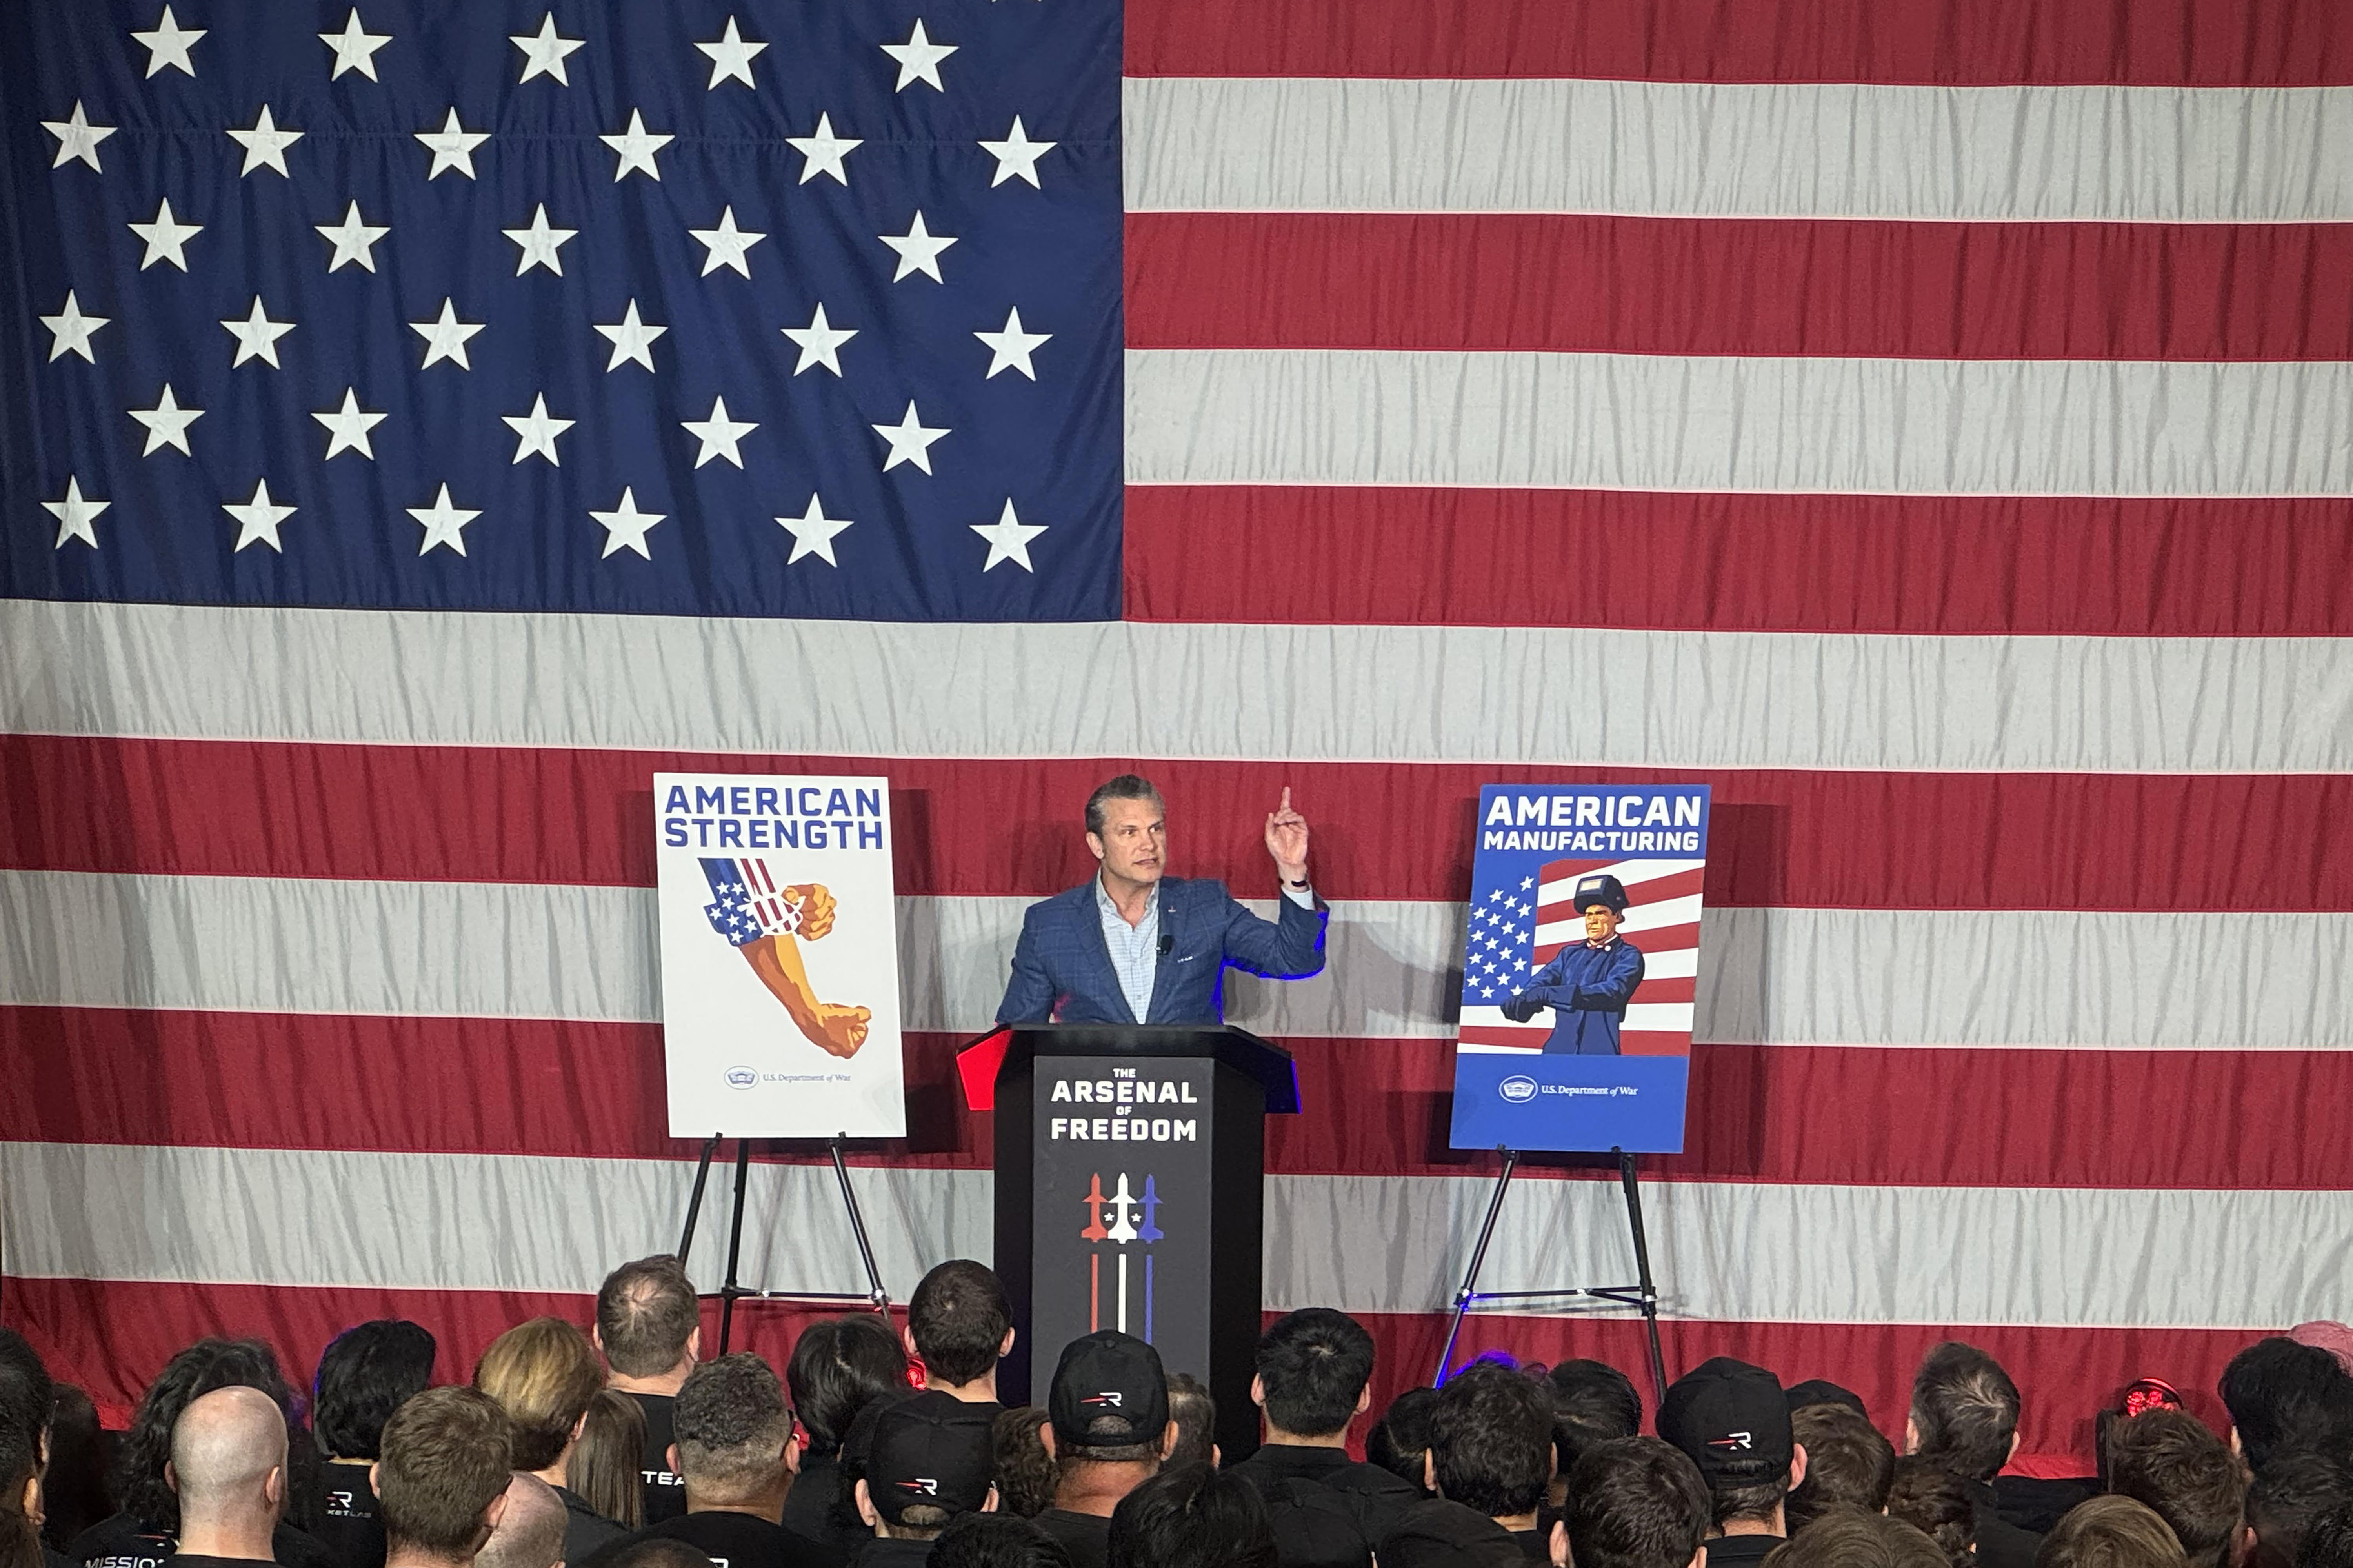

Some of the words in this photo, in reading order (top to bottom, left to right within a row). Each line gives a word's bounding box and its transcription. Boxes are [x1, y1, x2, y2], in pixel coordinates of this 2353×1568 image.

[665, 785, 880, 817] AMERICAN
[1485, 796, 1701, 827] AMERICAN
[665, 818, 883, 849] STRENGTH
[1484, 831, 1699, 851] MANUFACTURING
[778, 1074, 824, 1083] Department
[826, 1074, 834, 1082] of
[1113, 1068, 1136, 1078] THE
[1051, 1081, 1197, 1103] ARSENAL
[1541, 1085, 1557, 1094] U.S.
[1558, 1086, 1608, 1096] Department
[1609, 1086, 1620, 1097] of
[1620, 1087, 1639, 1095] War
[1116, 1106, 1132, 1115] OF
[1051, 1118, 1196, 1141] FREEDOM
[84, 1556, 165, 1568] MISSIO
